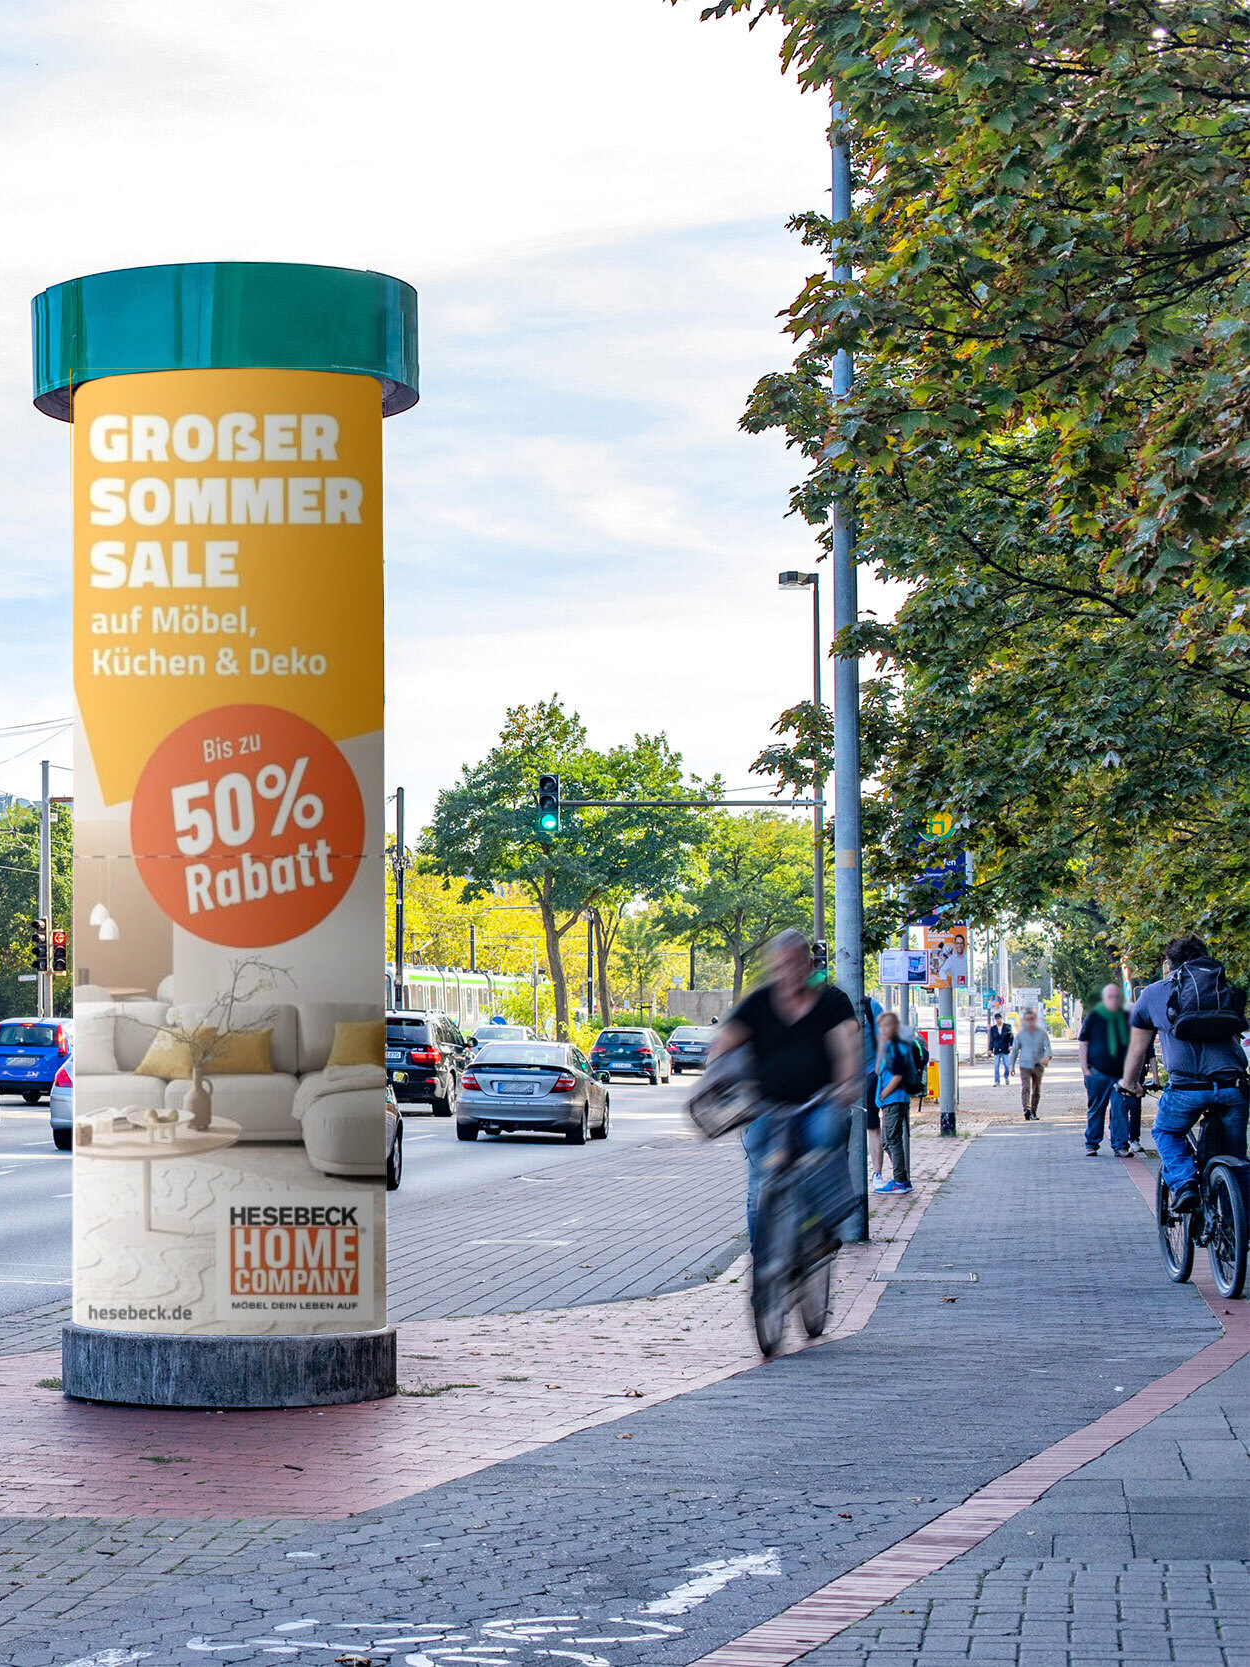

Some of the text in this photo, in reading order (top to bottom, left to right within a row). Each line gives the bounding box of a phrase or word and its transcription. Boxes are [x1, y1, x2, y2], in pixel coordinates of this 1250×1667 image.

[89, 412, 340, 463] GROßER
[89, 477, 363, 526] SOMMER
[89, 540, 239, 589] SALE
[91, 605, 257, 637] auf Möbel,
[92, 646, 327, 676] Küchen & Deko
[203, 734, 261, 763] Bis zu
[171, 756, 324, 857] 50%
[184, 838, 334, 916] Rabatt
[230, 1206, 359, 1226] HESEBECK
[234, 1228, 356, 1269] HOME
[234, 1269, 356, 1293] COMPANY
[88, 1304, 193, 1320] hesebeck.de
[231, 1301, 359, 1310] MÖBEL DEIN LEBEN AUF
